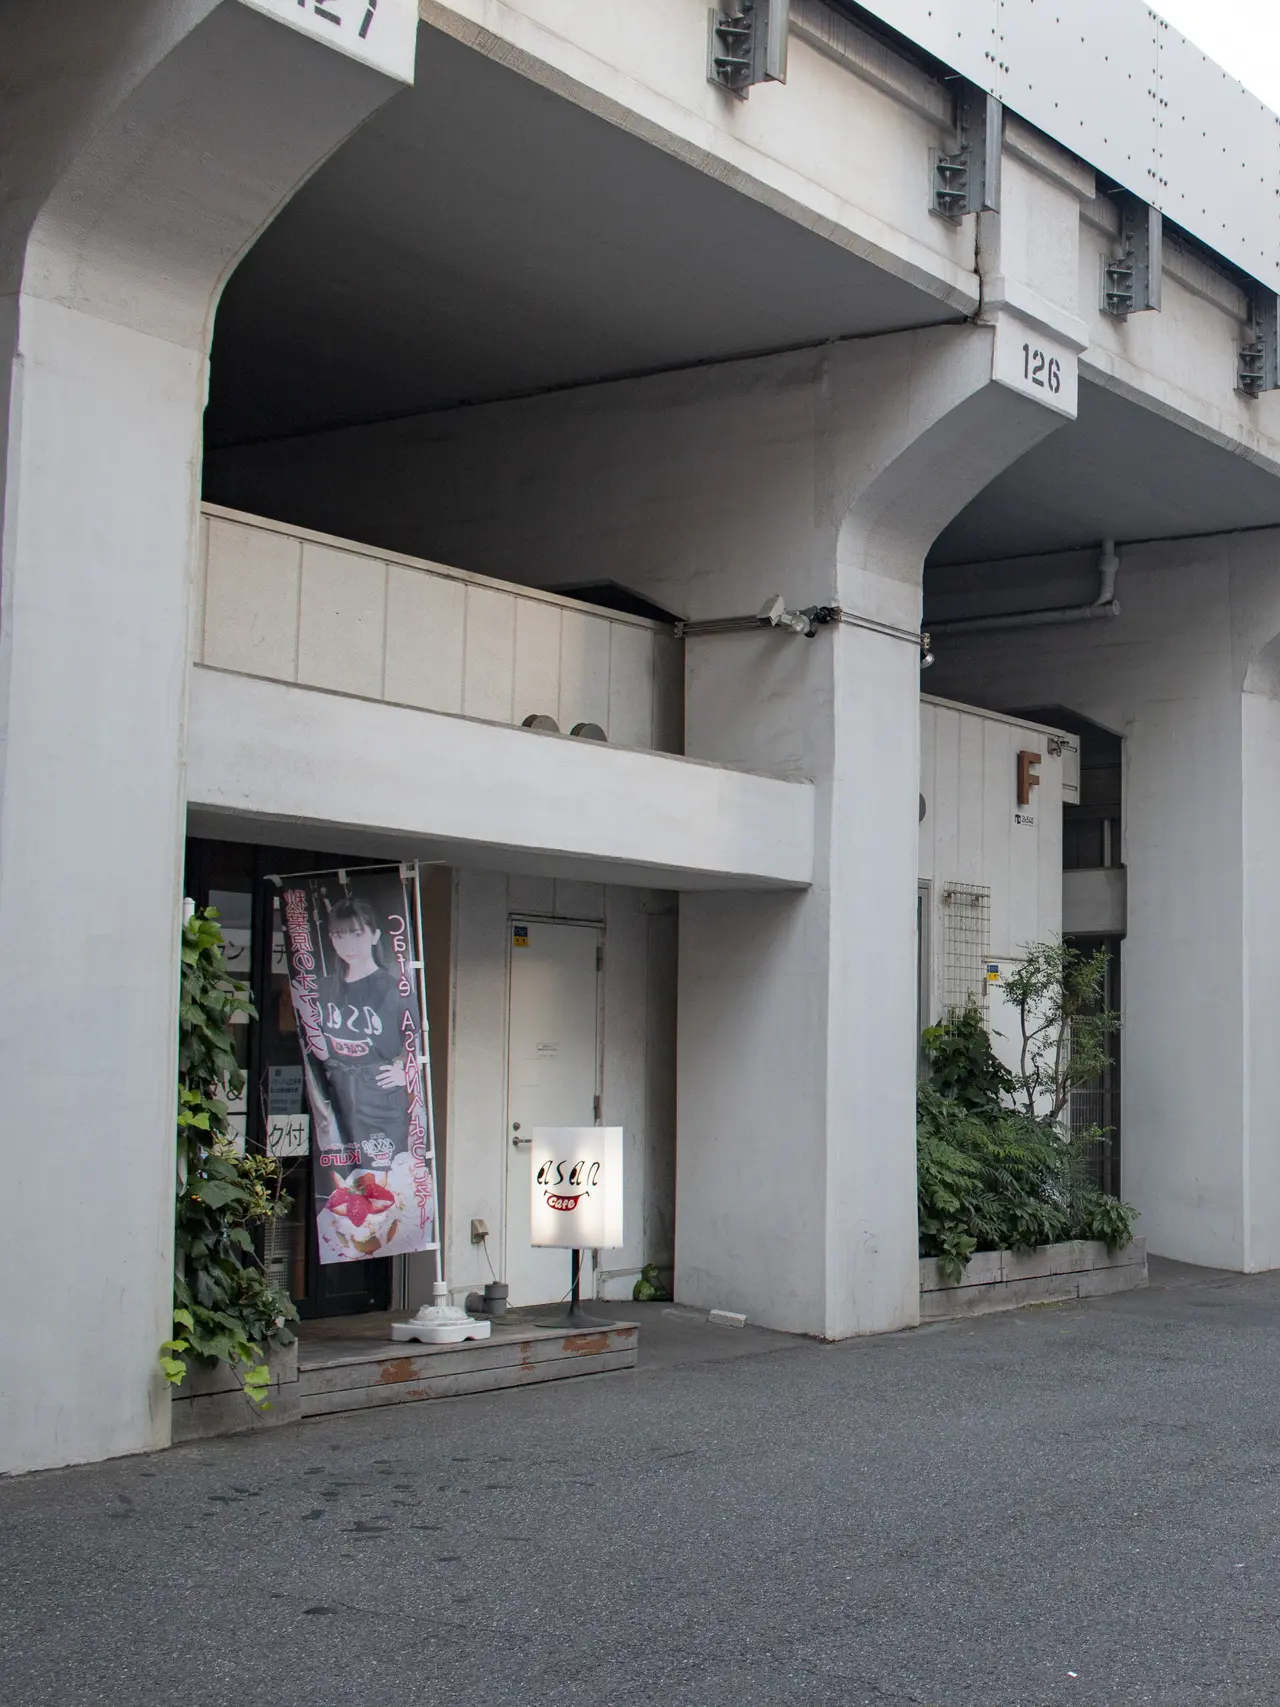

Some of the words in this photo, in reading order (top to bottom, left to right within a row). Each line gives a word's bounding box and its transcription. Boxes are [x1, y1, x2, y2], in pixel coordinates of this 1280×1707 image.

[1022, 343, 1061, 394] 126
[1017, 750, 1042, 805] F
[537, 1160, 600, 1186] asan
